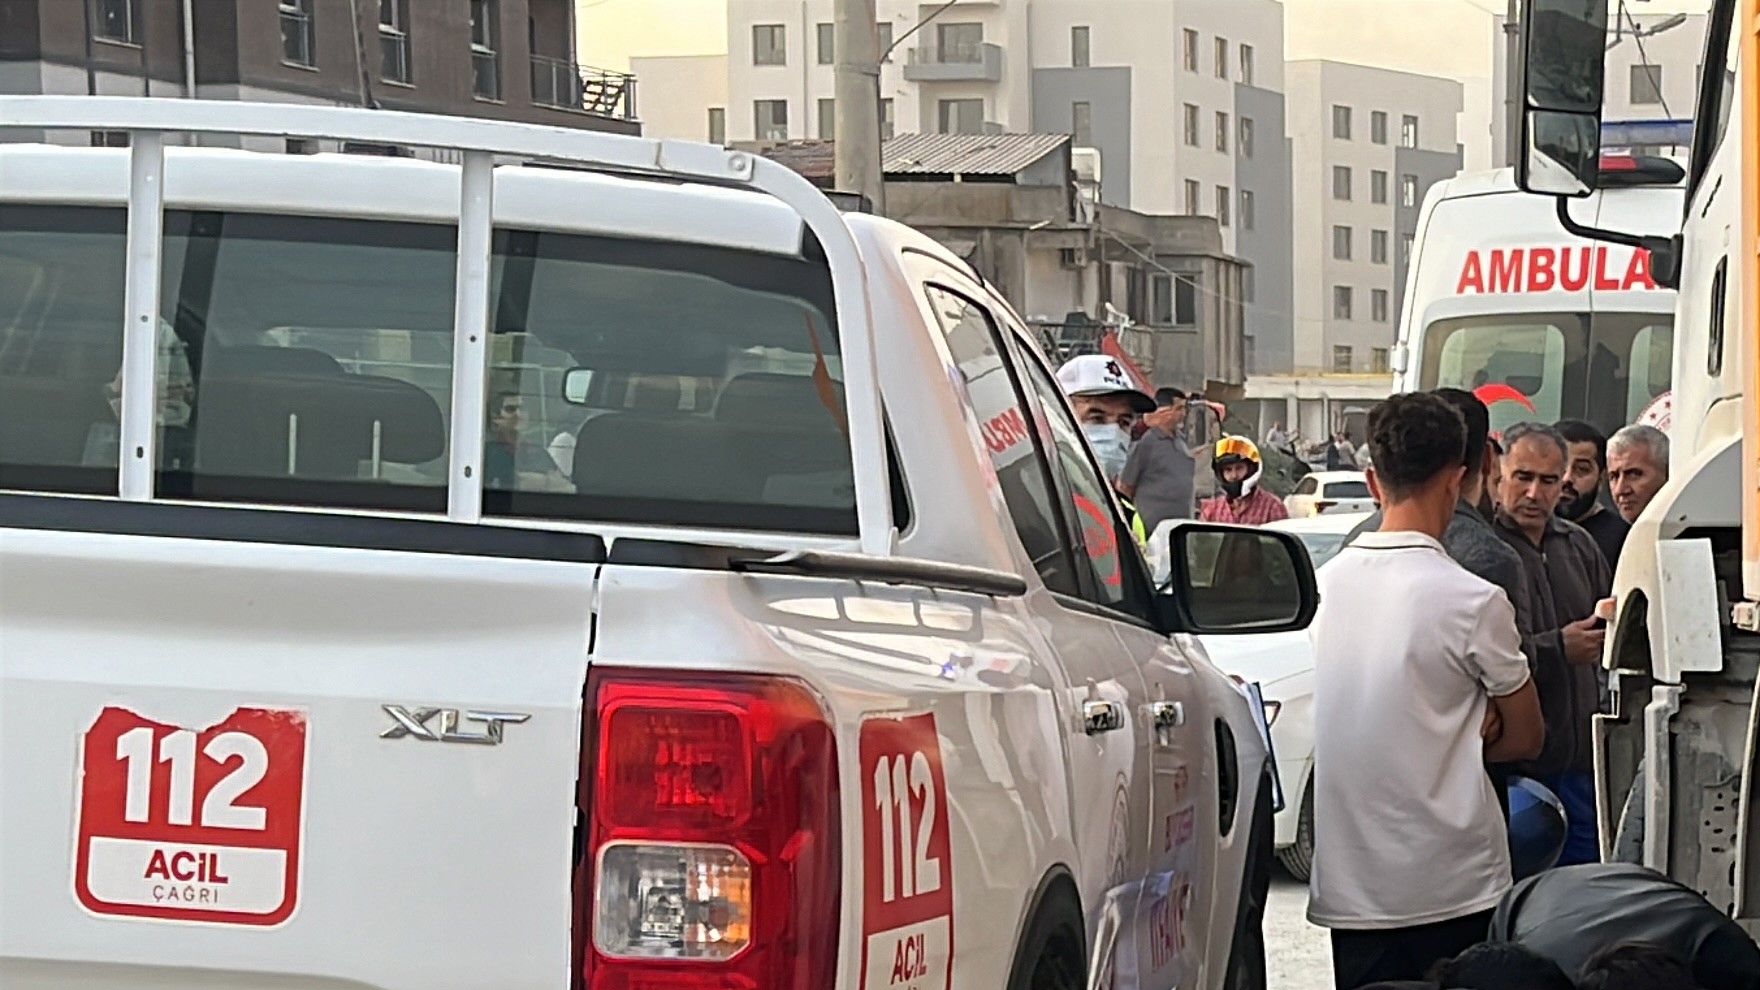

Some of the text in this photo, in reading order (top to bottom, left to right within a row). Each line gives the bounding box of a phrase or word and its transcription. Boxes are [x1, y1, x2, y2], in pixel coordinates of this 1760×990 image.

[1456, 246, 1662, 294] AMBULA
[379, 704, 532, 746] XLT
[116, 727, 269, 831] 112
[874, 750, 941, 903] 112
